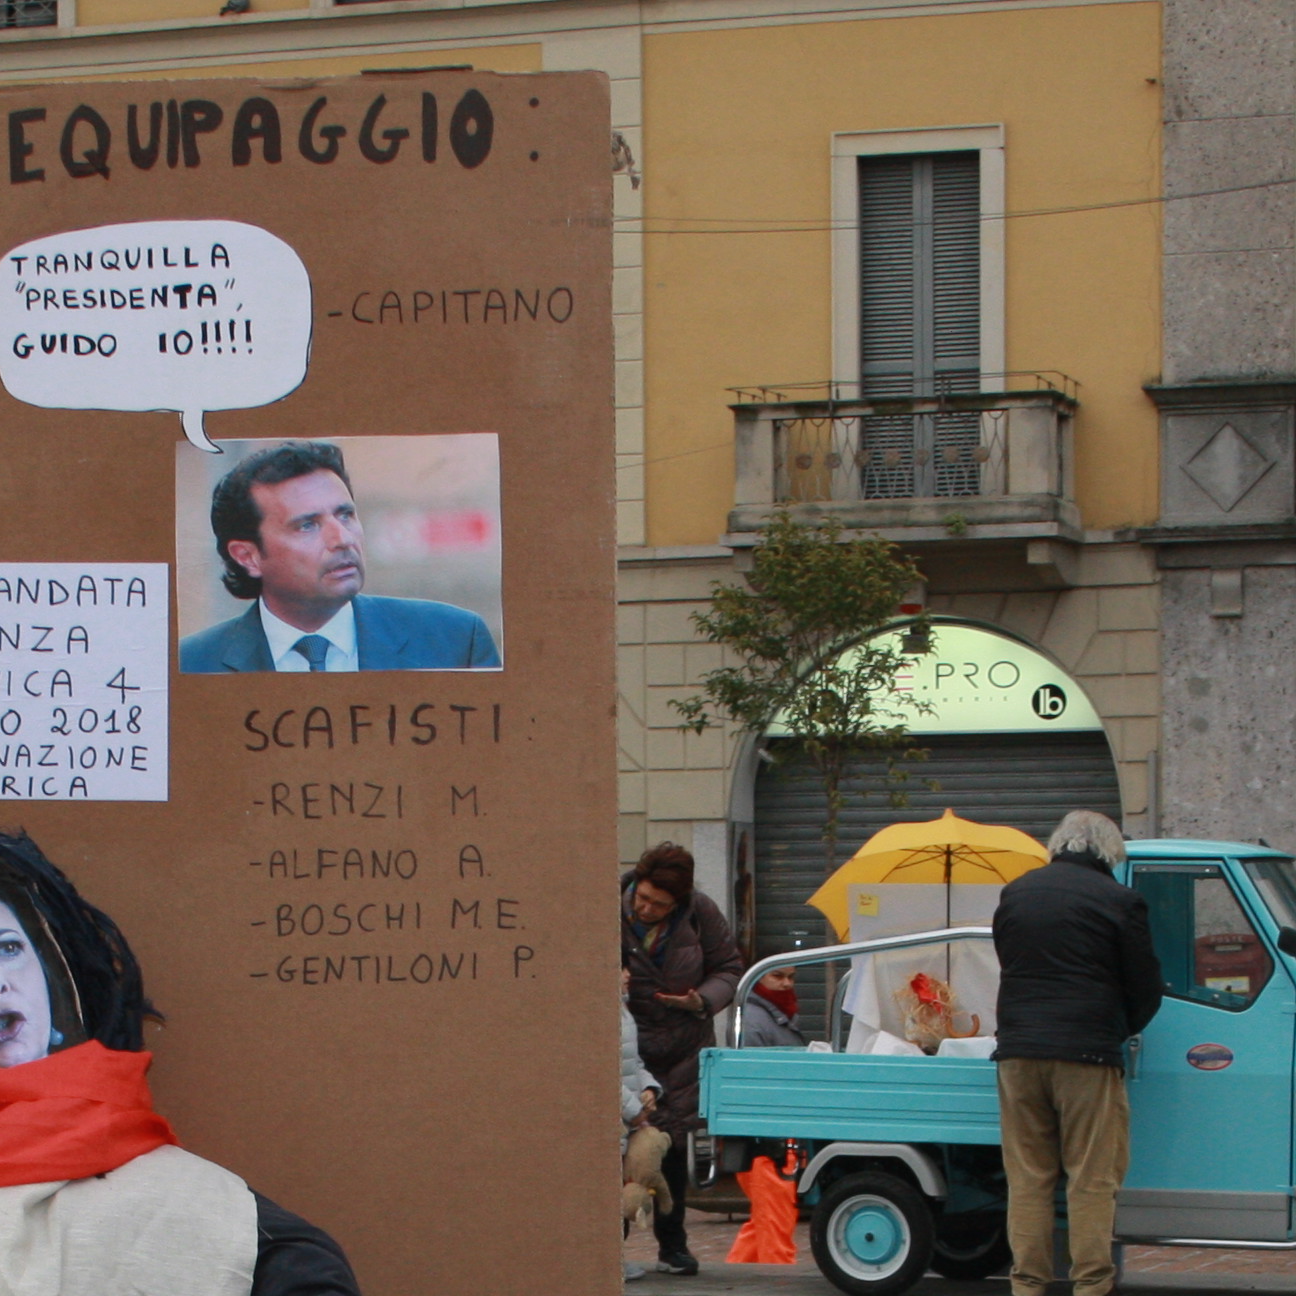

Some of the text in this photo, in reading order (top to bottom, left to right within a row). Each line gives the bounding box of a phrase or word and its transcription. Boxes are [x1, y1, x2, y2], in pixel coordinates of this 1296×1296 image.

[10, 243, 231, 276] TRANQUILLA
[12, 318, 254, 358] GUIDO IO!!!!
[106, 666, 142, 705] 4
[50, 706, 143, 737] 2018
[450, 785, 488, 817] M.
[458, 844, 492, 879] A.
[512, 945, 536, 980] P.
